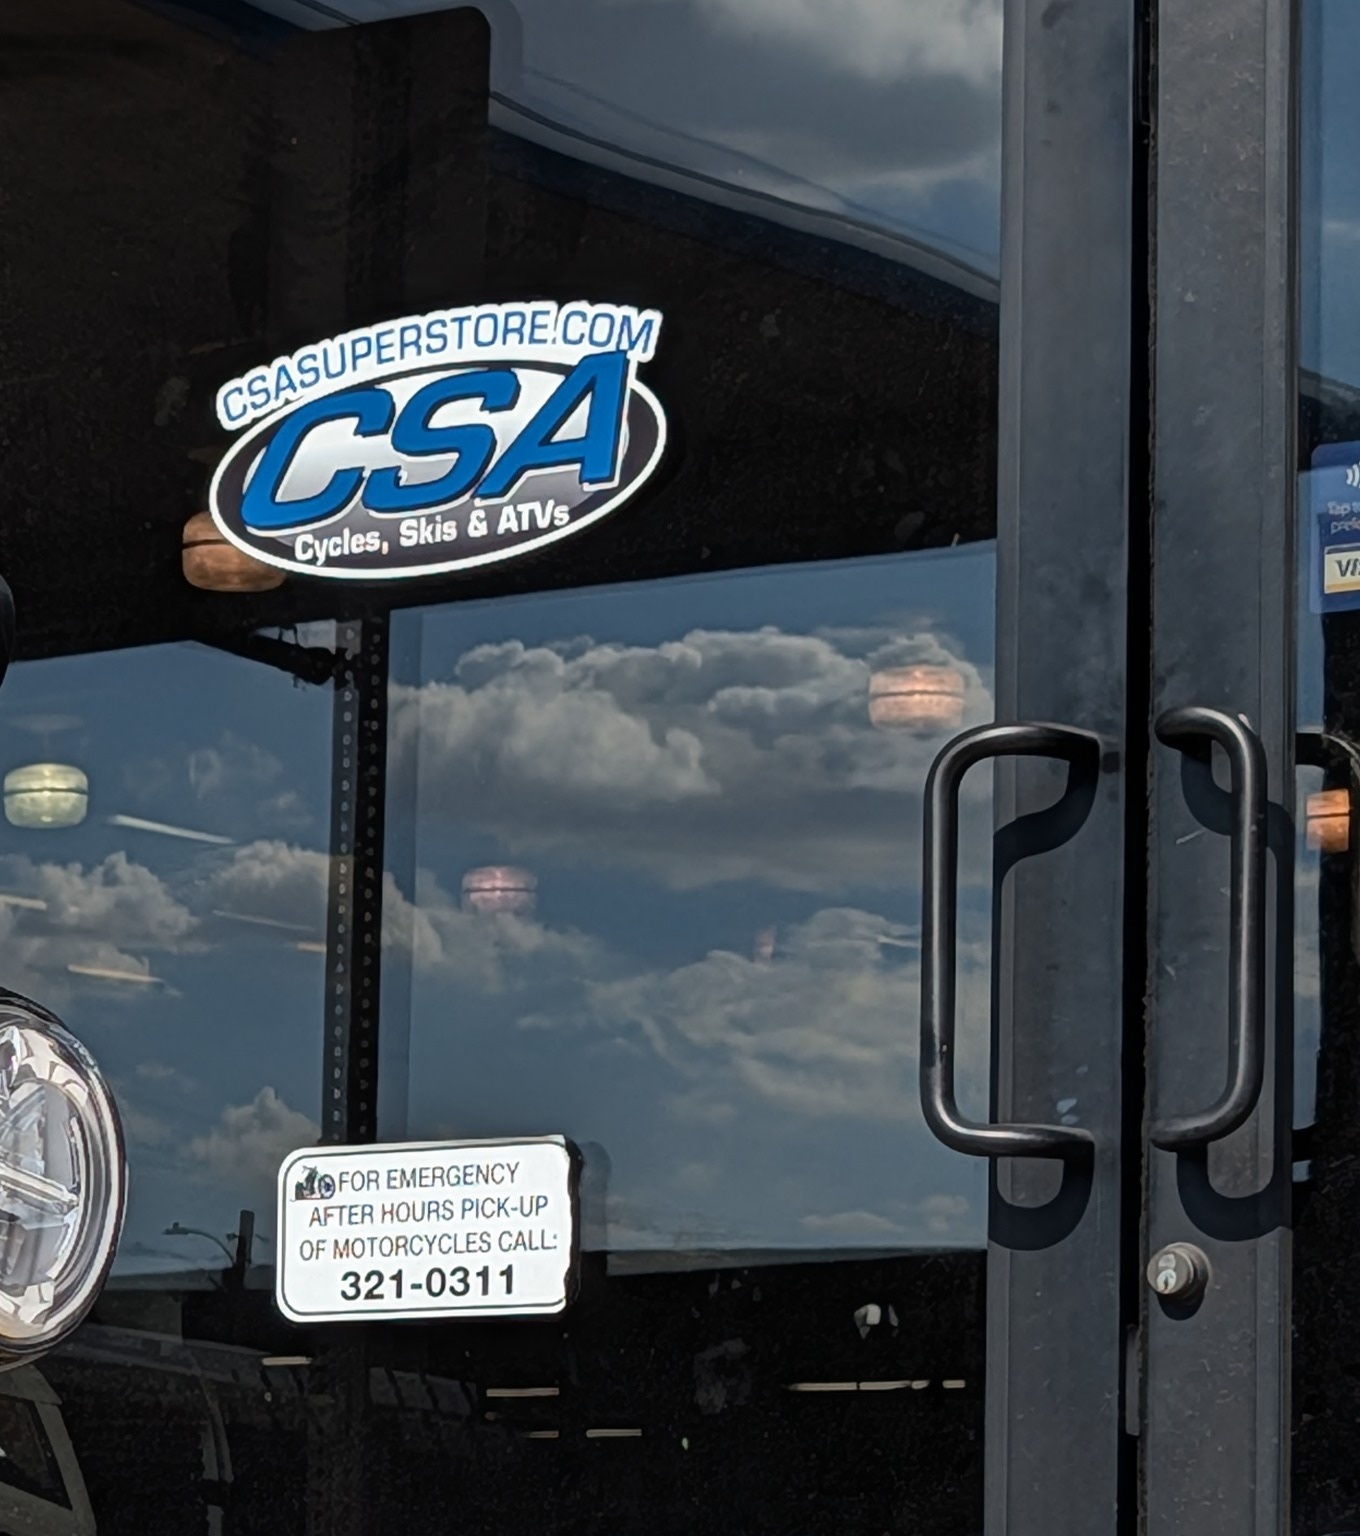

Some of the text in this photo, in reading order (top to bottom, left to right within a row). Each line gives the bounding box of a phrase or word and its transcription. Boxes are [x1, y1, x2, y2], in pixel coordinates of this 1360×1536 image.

[222, 309, 655, 423] CSASUPERSTORE.COM
[241, 350, 629, 531] CSA
[294, 499, 570, 565] Cycles, Skis & ATVs
[338, 1162, 520, 1193] FOR EMERGENCY
[309, 1195, 549, 1227] AFTER HOURS PICK-UP
[299, 1229, 558, 1261] OF MOTORCYCLES CALL:
[340, 1264, 515, 1301] 321-0311
